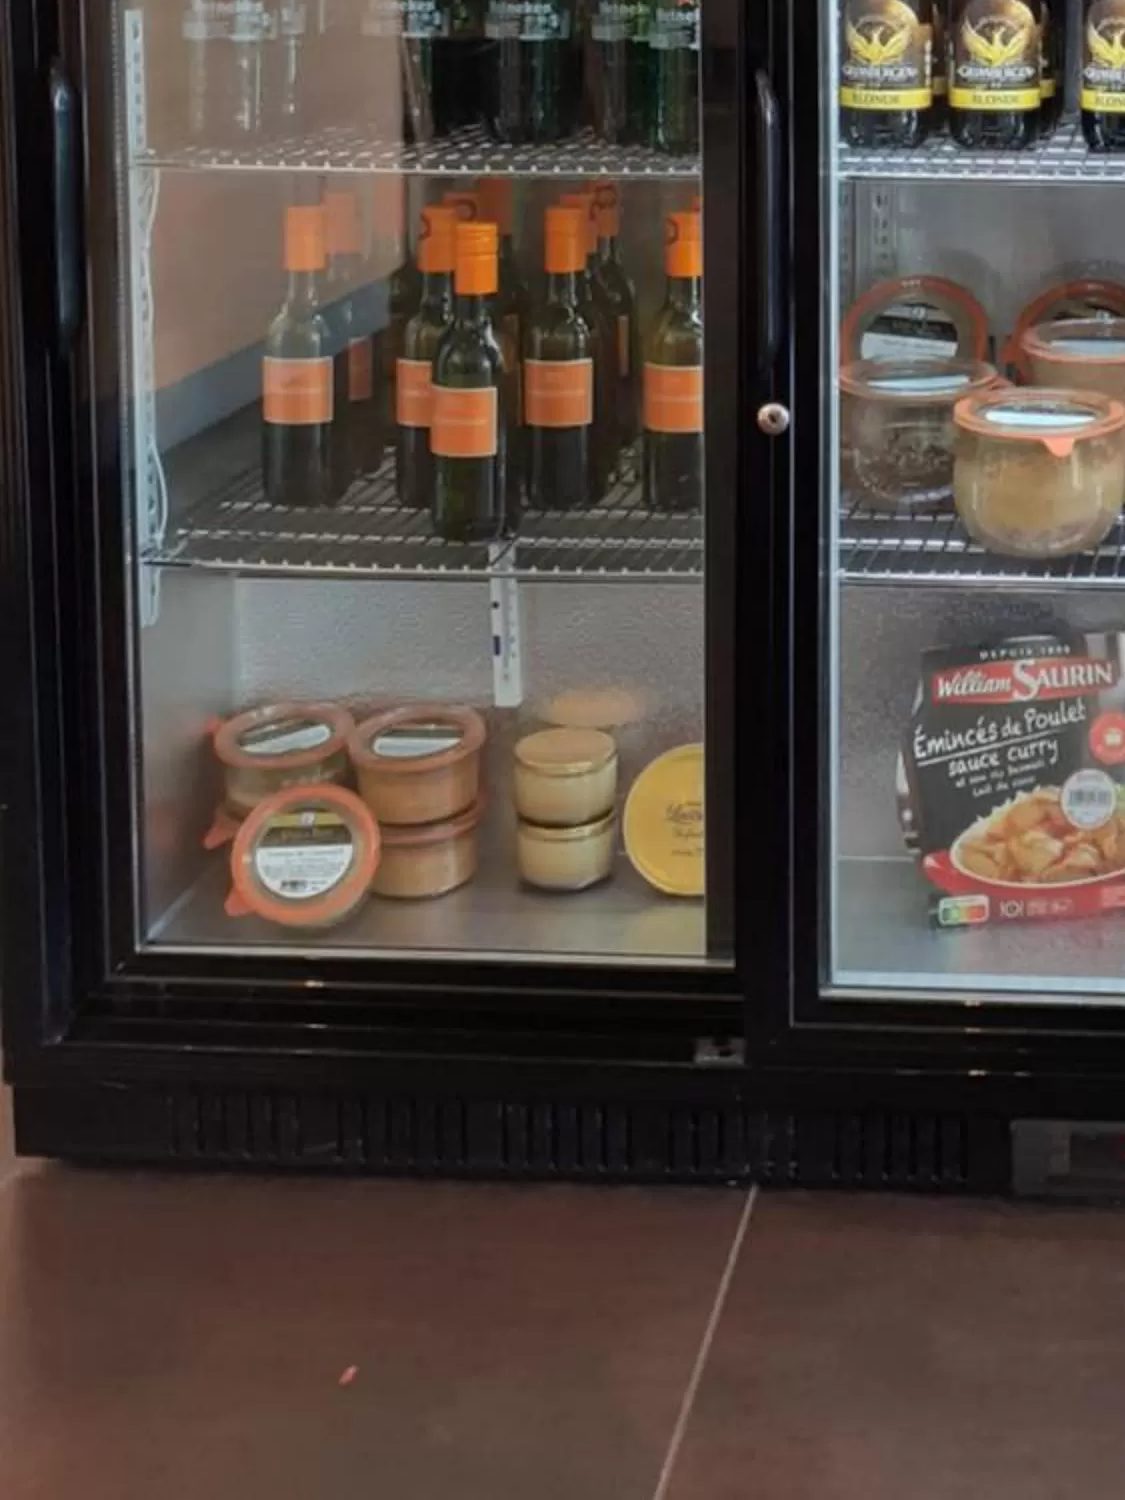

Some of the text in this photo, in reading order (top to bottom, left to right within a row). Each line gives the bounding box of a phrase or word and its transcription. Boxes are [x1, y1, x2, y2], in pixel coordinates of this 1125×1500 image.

[936, 659, 1114, 701] William SAURIN
[1001, 716, 1021, 739] de
[1023, 697, 1087, 734] Poulet
[947, 738, 1058, 778] sauce curry
